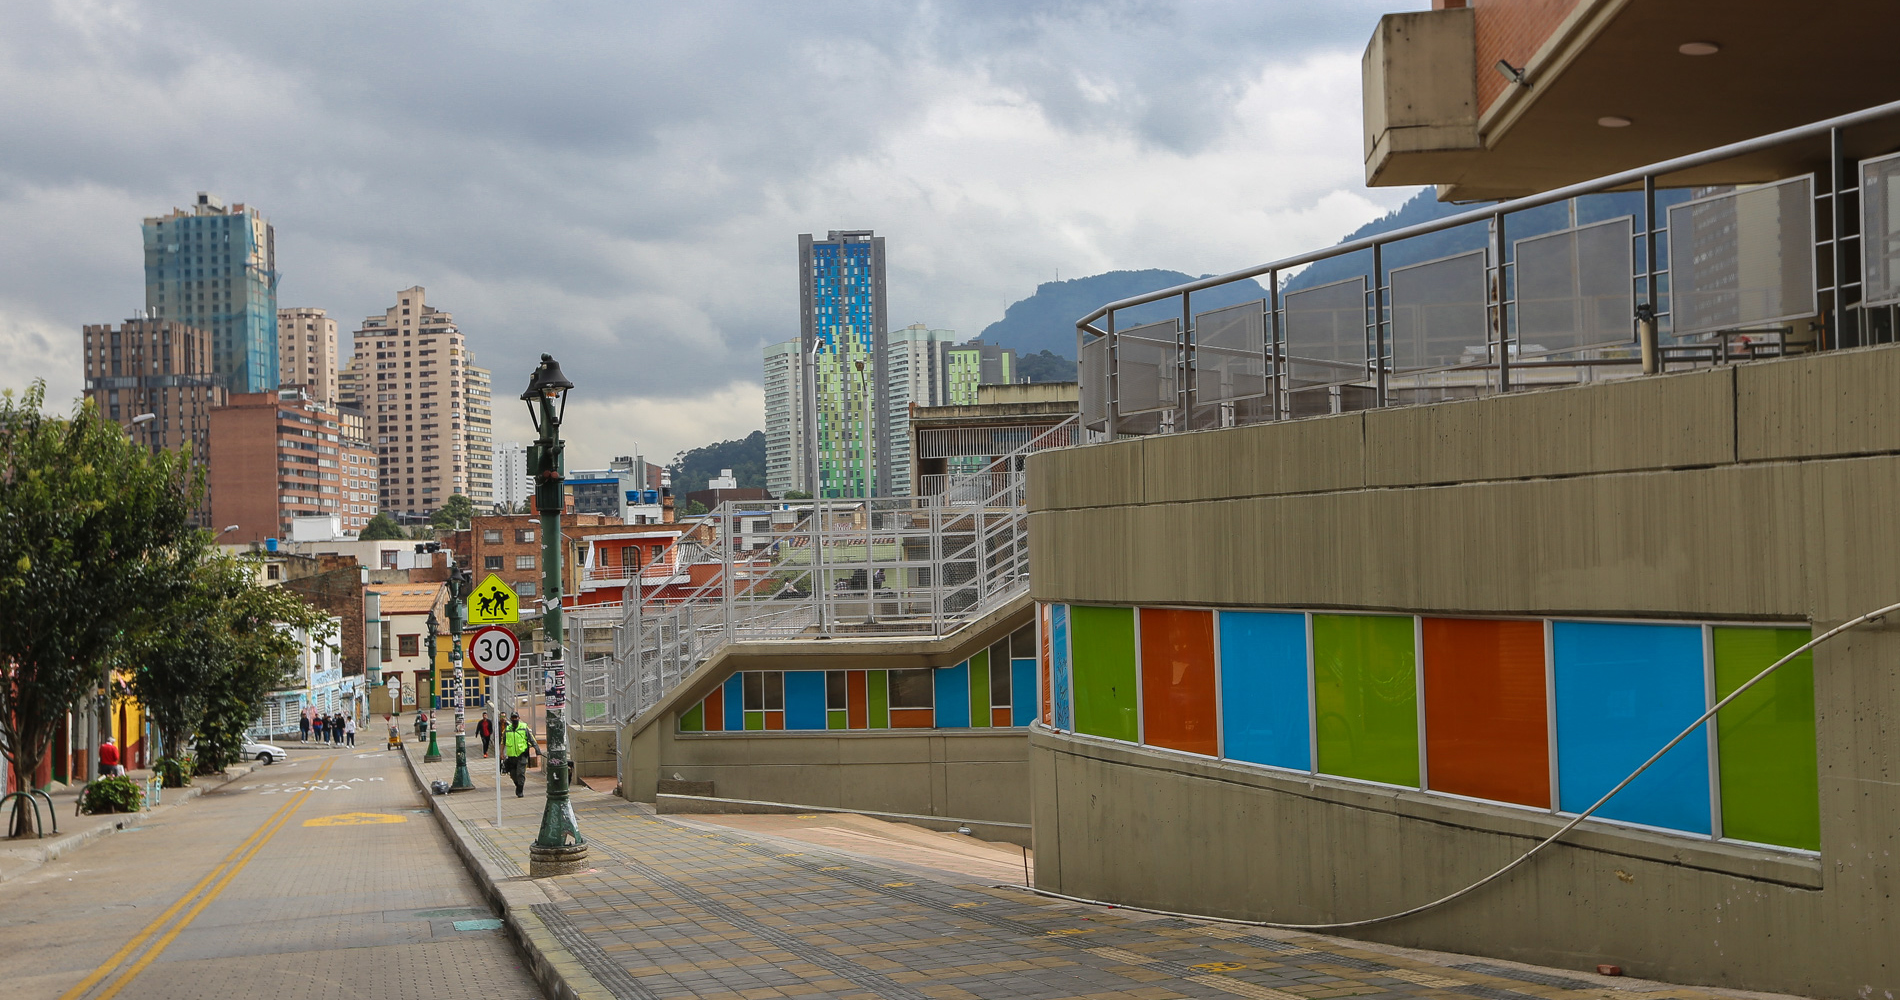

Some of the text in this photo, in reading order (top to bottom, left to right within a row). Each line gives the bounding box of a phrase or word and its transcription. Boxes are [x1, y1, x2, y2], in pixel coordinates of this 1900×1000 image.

[479, 638, 510, 662] 30
[241, 777, 384, 790] ESCOLAR
[260, 784, 352, 795] ZONA
